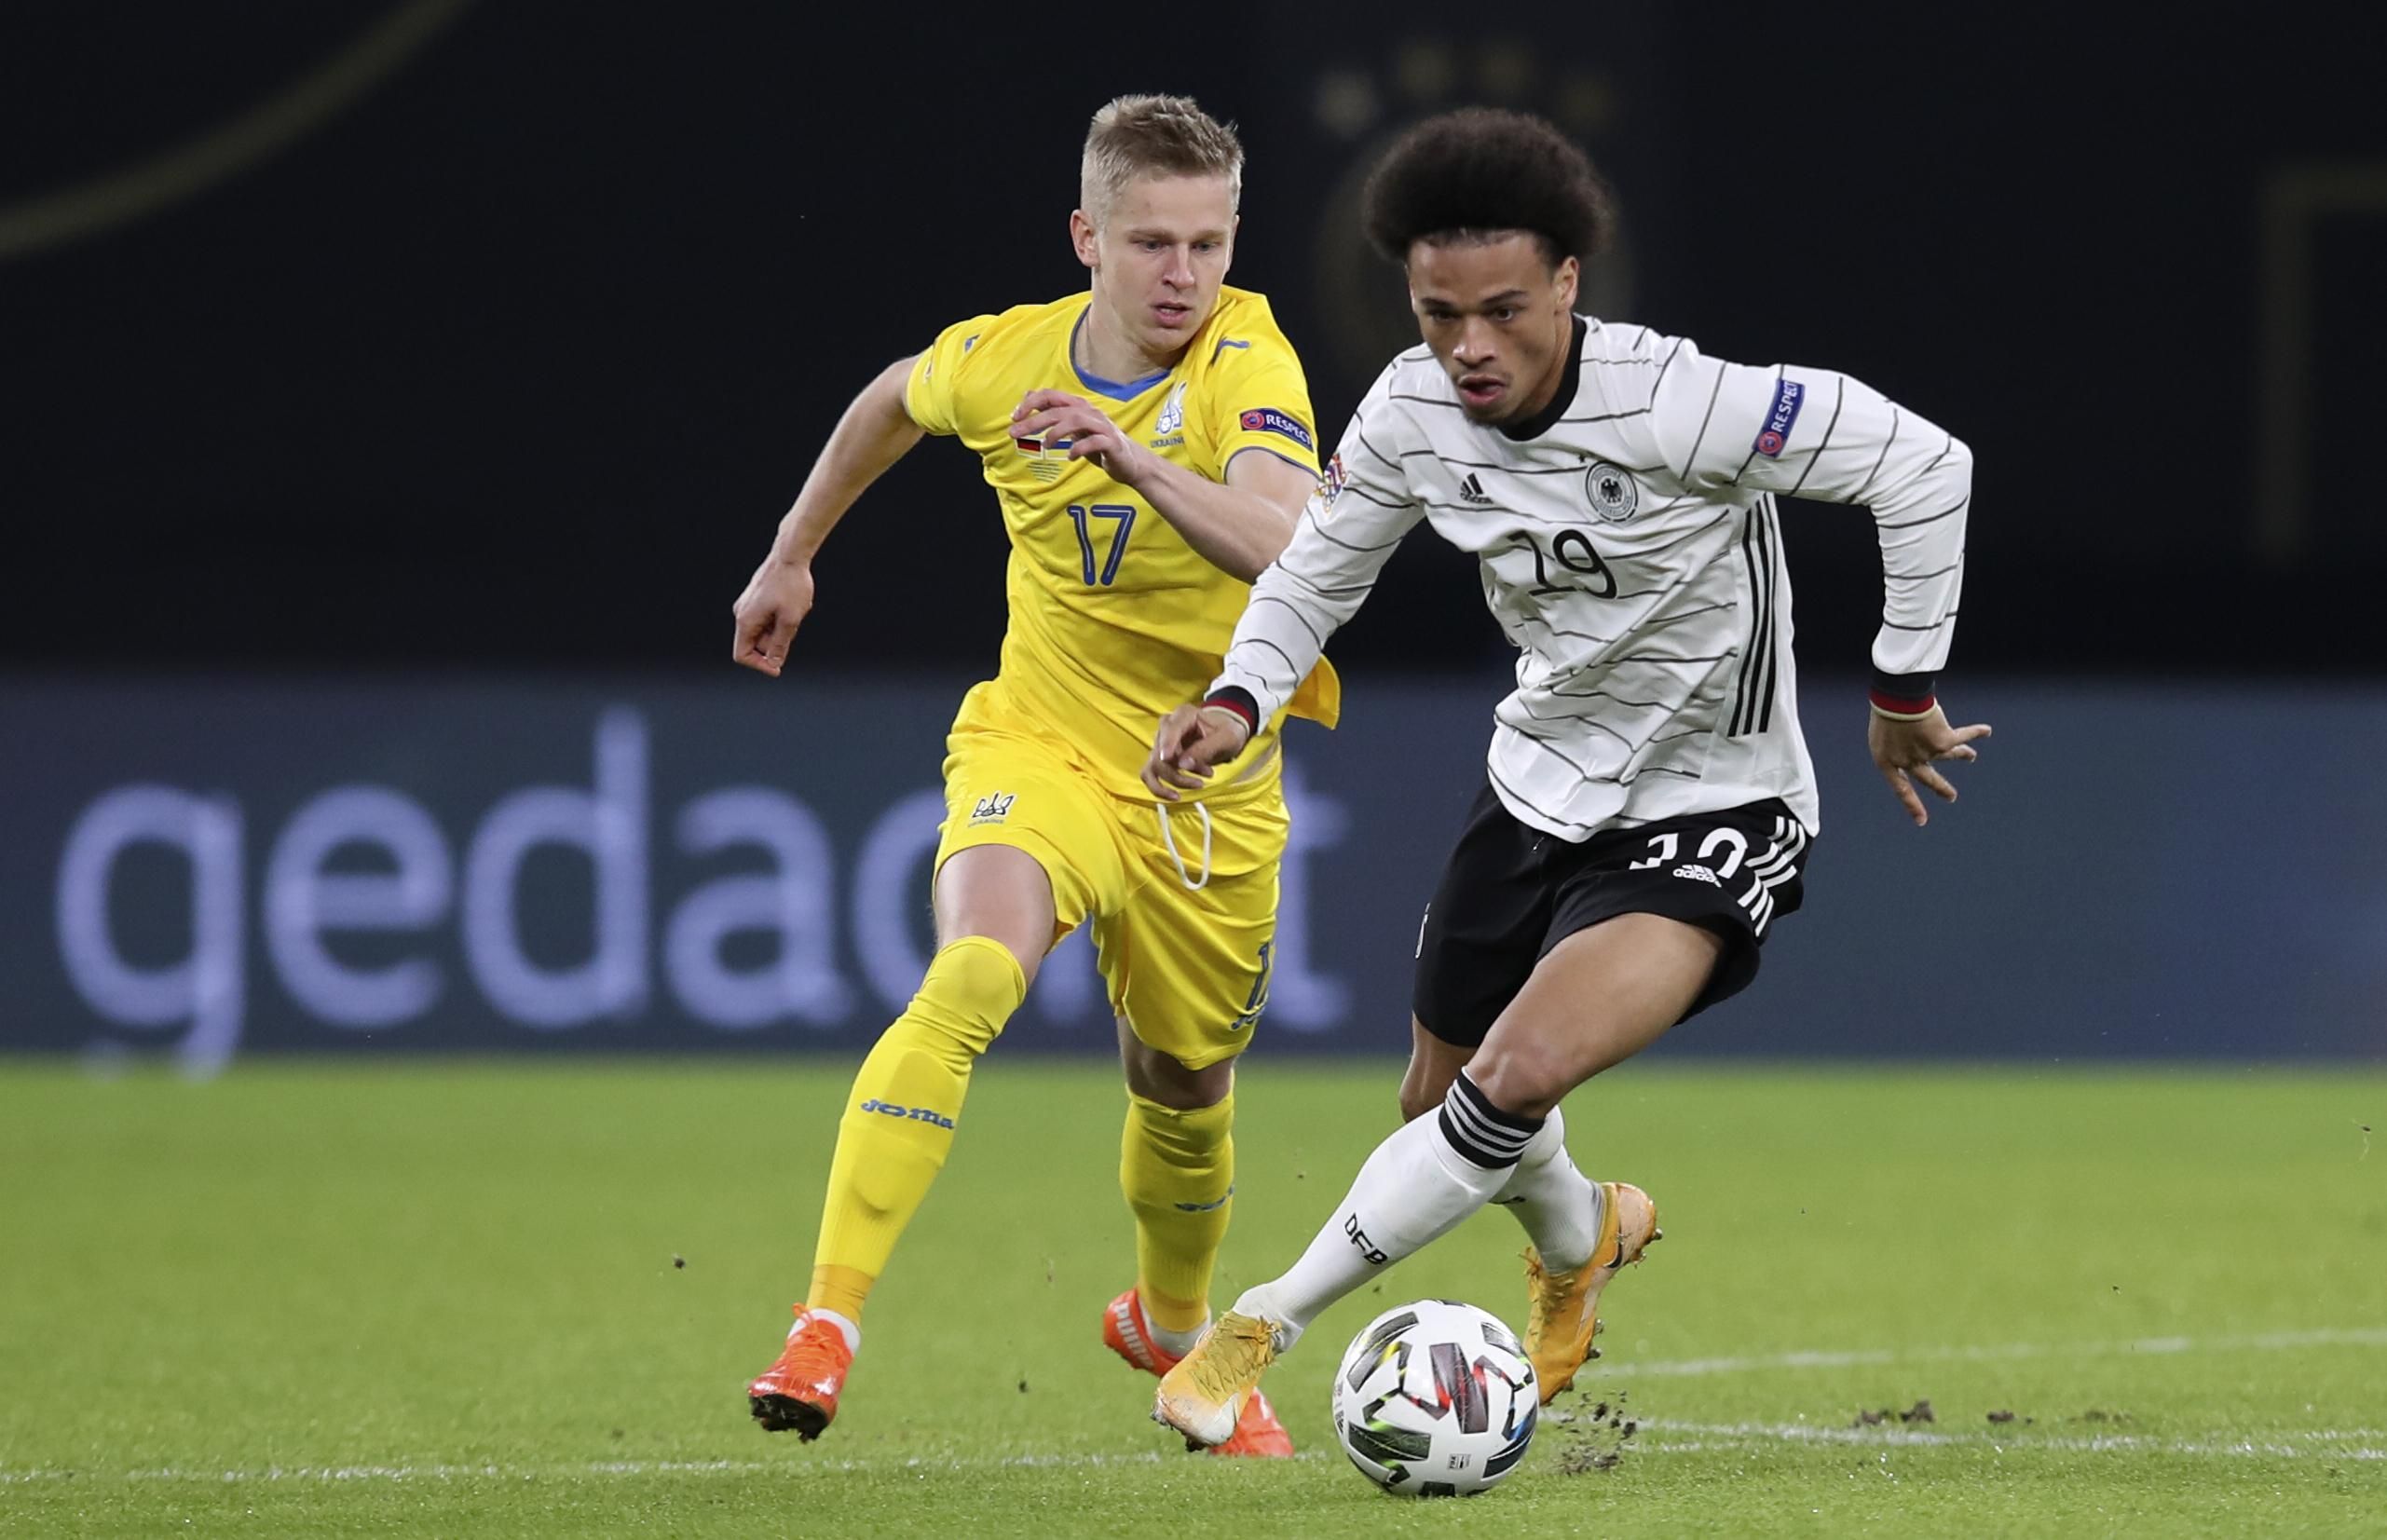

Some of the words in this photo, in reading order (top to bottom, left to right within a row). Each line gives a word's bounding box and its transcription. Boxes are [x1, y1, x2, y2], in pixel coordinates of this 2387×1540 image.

[1265, 414, 1311, 445] RESPECT
[1771, 381, 1798, 433] RESPECT
[1067, 505, 1138, 587] 17
[1507, 528, 1617, 599] 19
[1344, 1212, 1388, 1265] DFB
